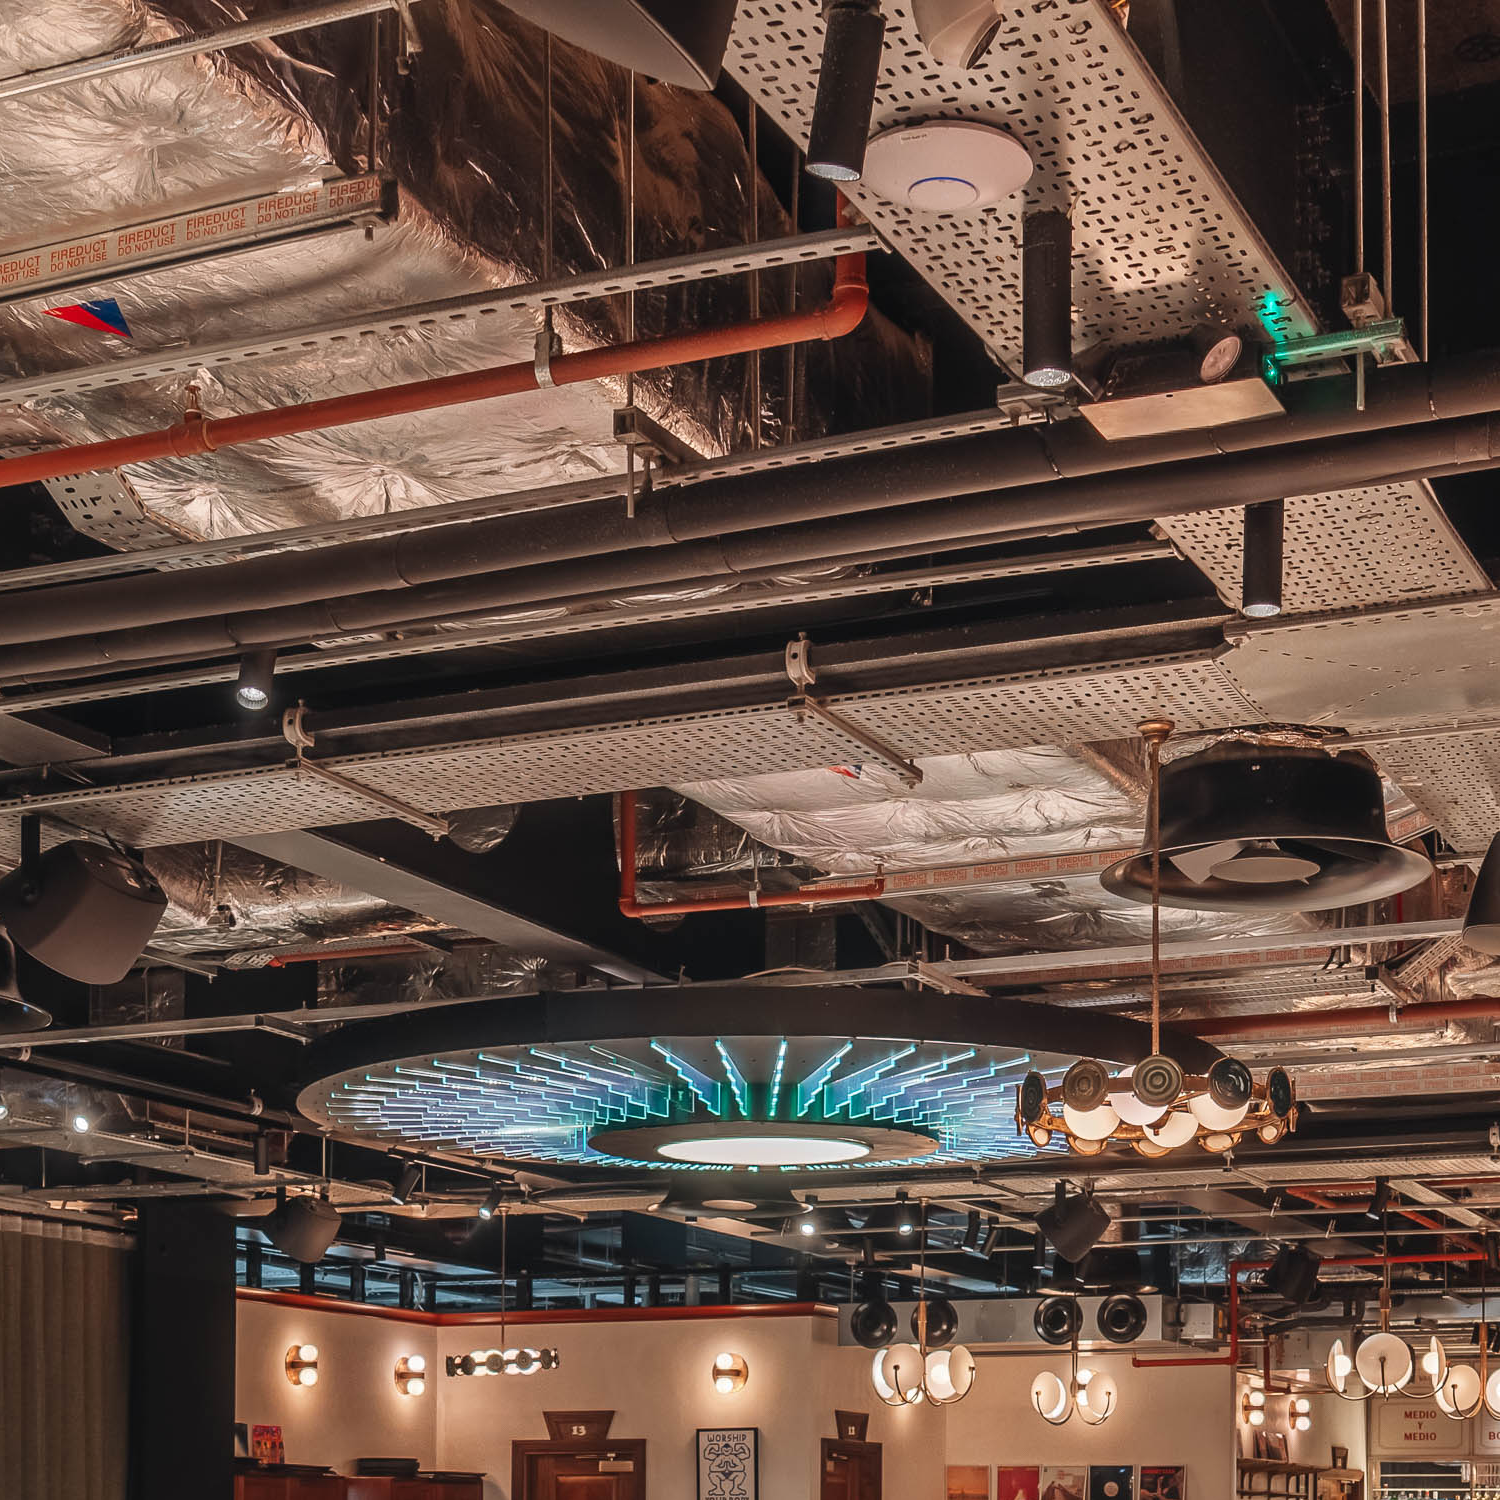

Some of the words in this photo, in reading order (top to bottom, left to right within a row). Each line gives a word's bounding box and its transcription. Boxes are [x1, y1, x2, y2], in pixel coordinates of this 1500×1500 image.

[329, 176, 380, 198] FIREDUC
[257, 190, 318, 214] FIREDUCT
[187, 206, 247, 230] FIREDUCT
[257, 213, 272, 224] DO
[275, 208, 295, 221] NOT
[298, 204, 318, 216] USE
[118, 223, 176, 245] FIREDUCT
[187, 229, 201, 240] DO
[204, 224, 224, 237] NOT
[227, 219, 247, 232] USE
[51, 240, 107, 262] FIREDUCT
[118, 245, 132, 256] DO
[135, 241, 154, 253] NOT
[157, 236, 176, 248] USE
[51, 260, 64, 272] DO
[67, 255, 86, 269] NOT
[89, 251, 107, 265] USE
[1, 271, 20, 285] NOT
[23, 267, 41, 280] USE
[1404, 1410, 1437, 1419] MEDIO
[571, 1426, 587, 1436] 13
[1418, 1422, 1423, 1430] Y
[707, 1434, 747, 1442] WORSHIP
[1404, 1432, 1437, 1441] MEDIO
